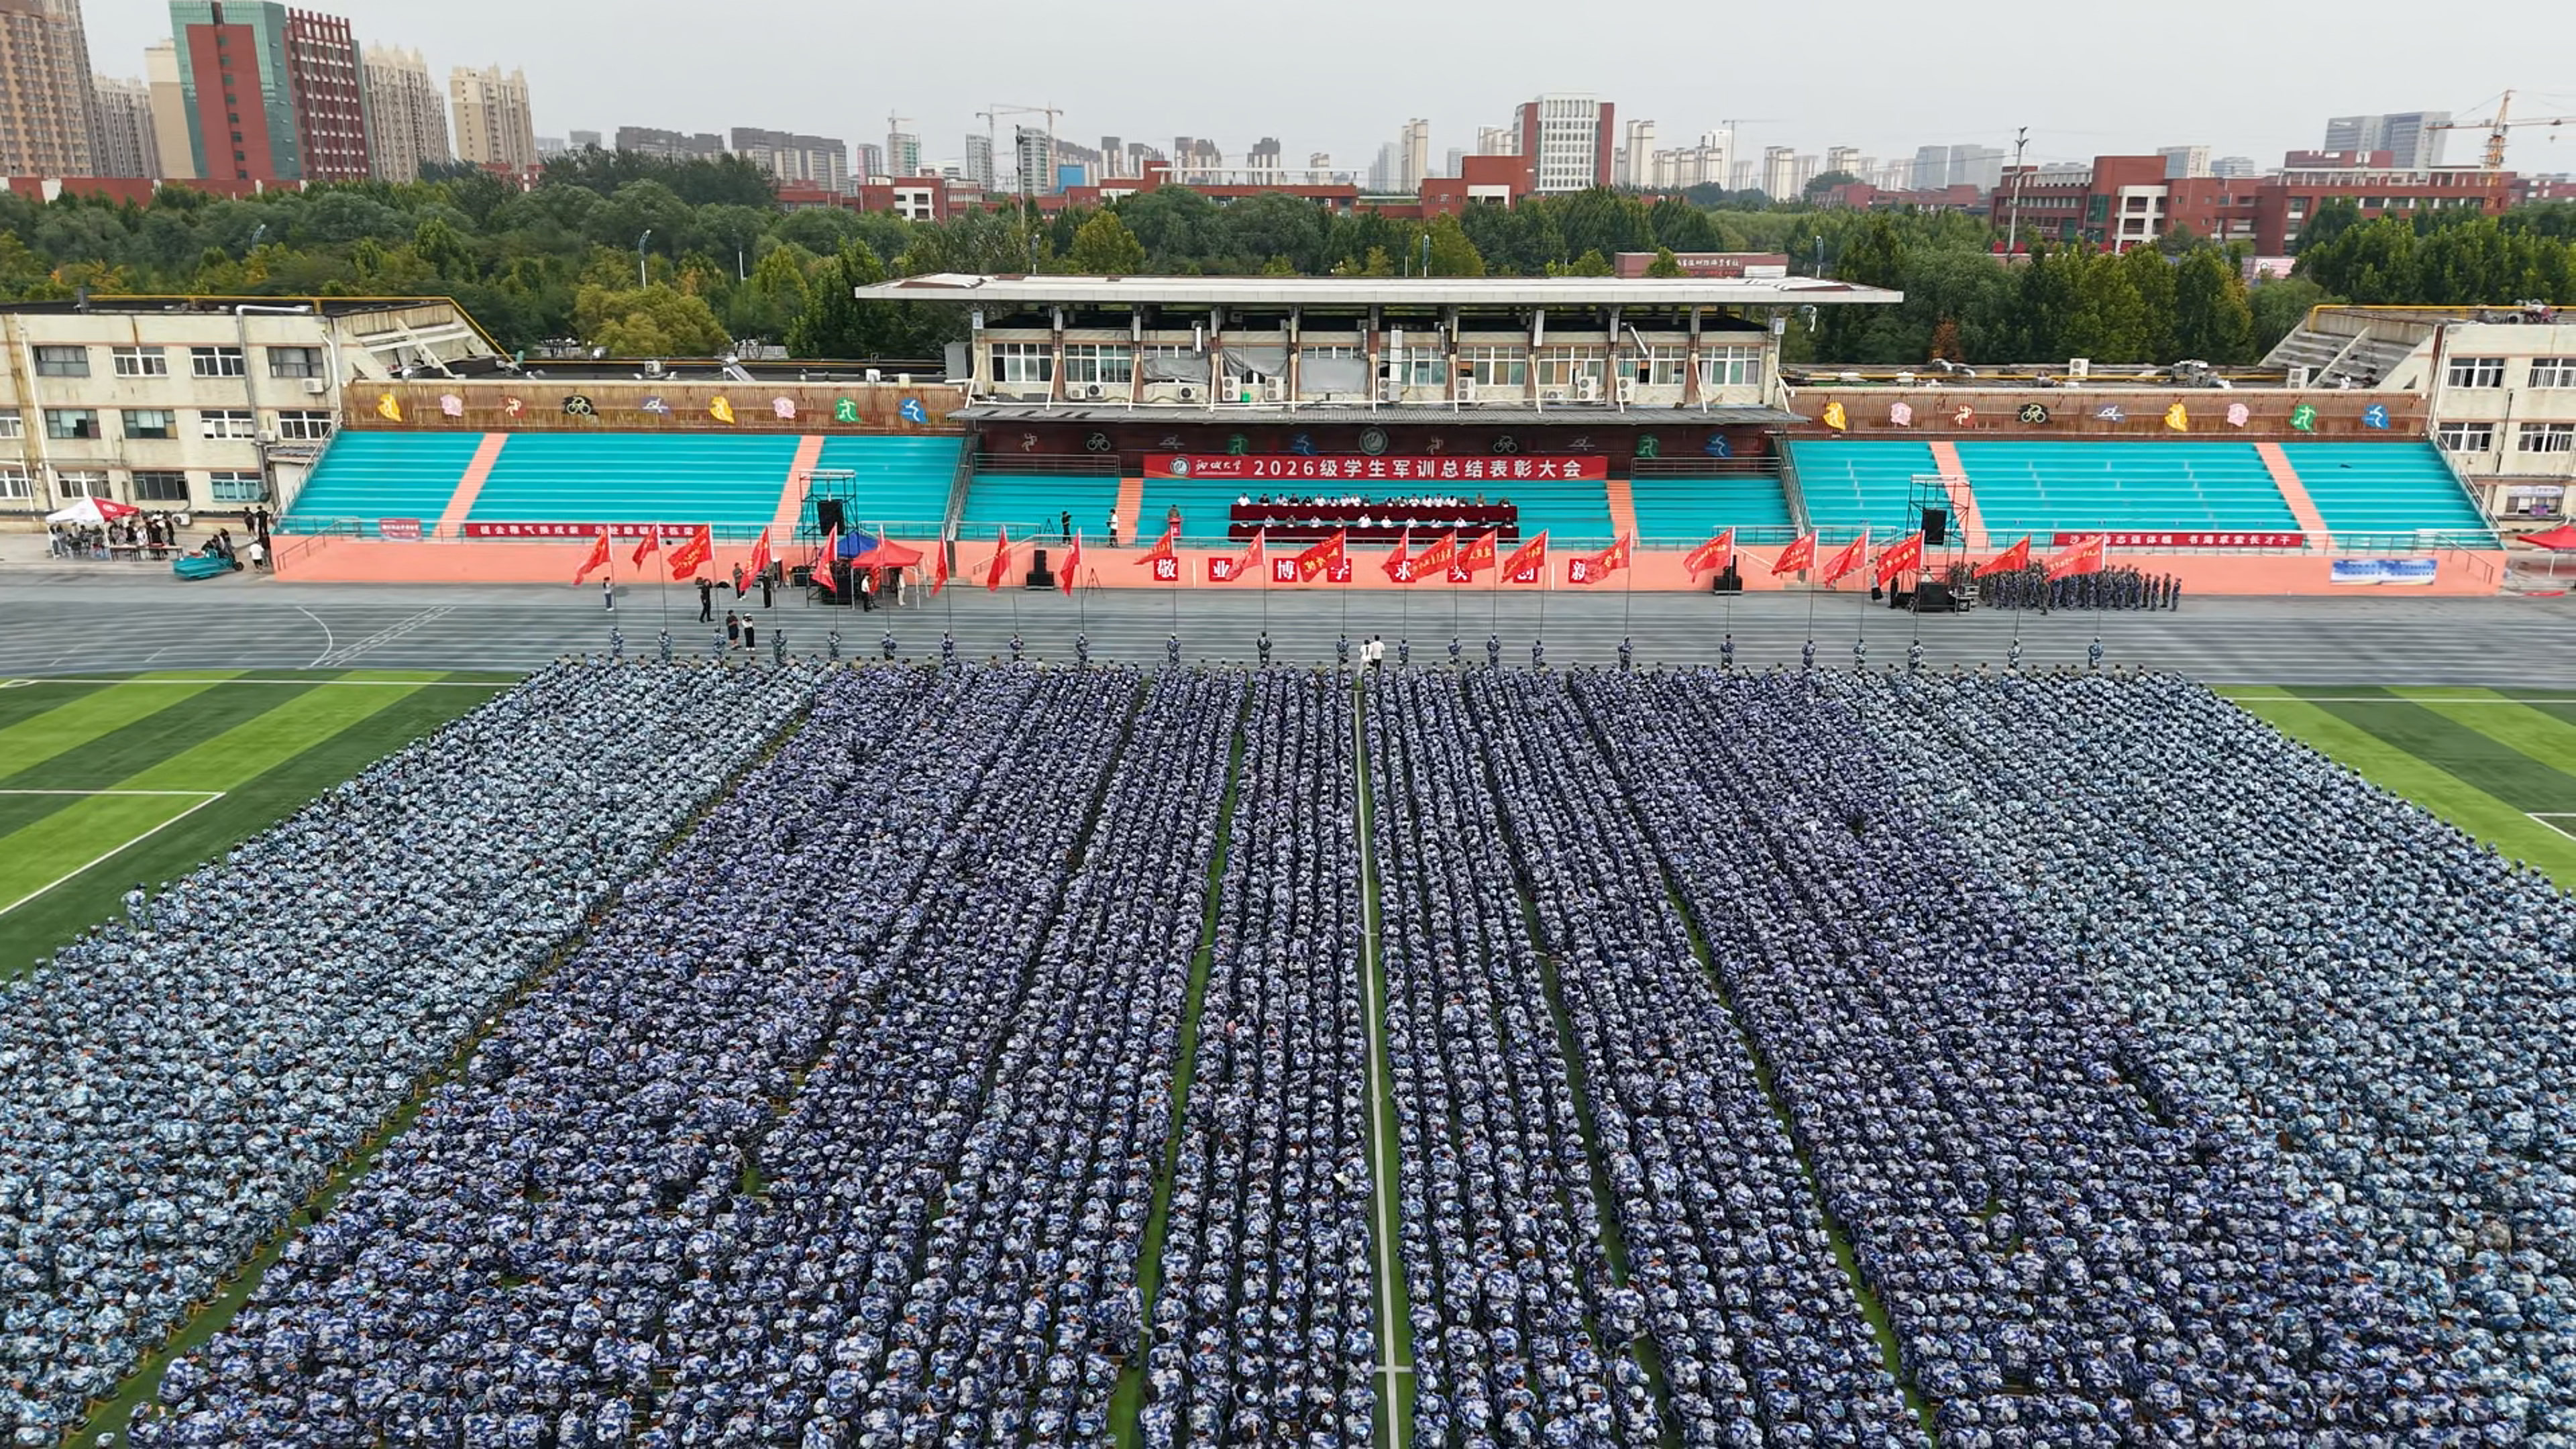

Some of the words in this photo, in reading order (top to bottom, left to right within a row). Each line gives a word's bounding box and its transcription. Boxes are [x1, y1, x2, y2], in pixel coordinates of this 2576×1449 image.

[1254, 459, 1582, 478] 2026级学生军训总结表彰大会
